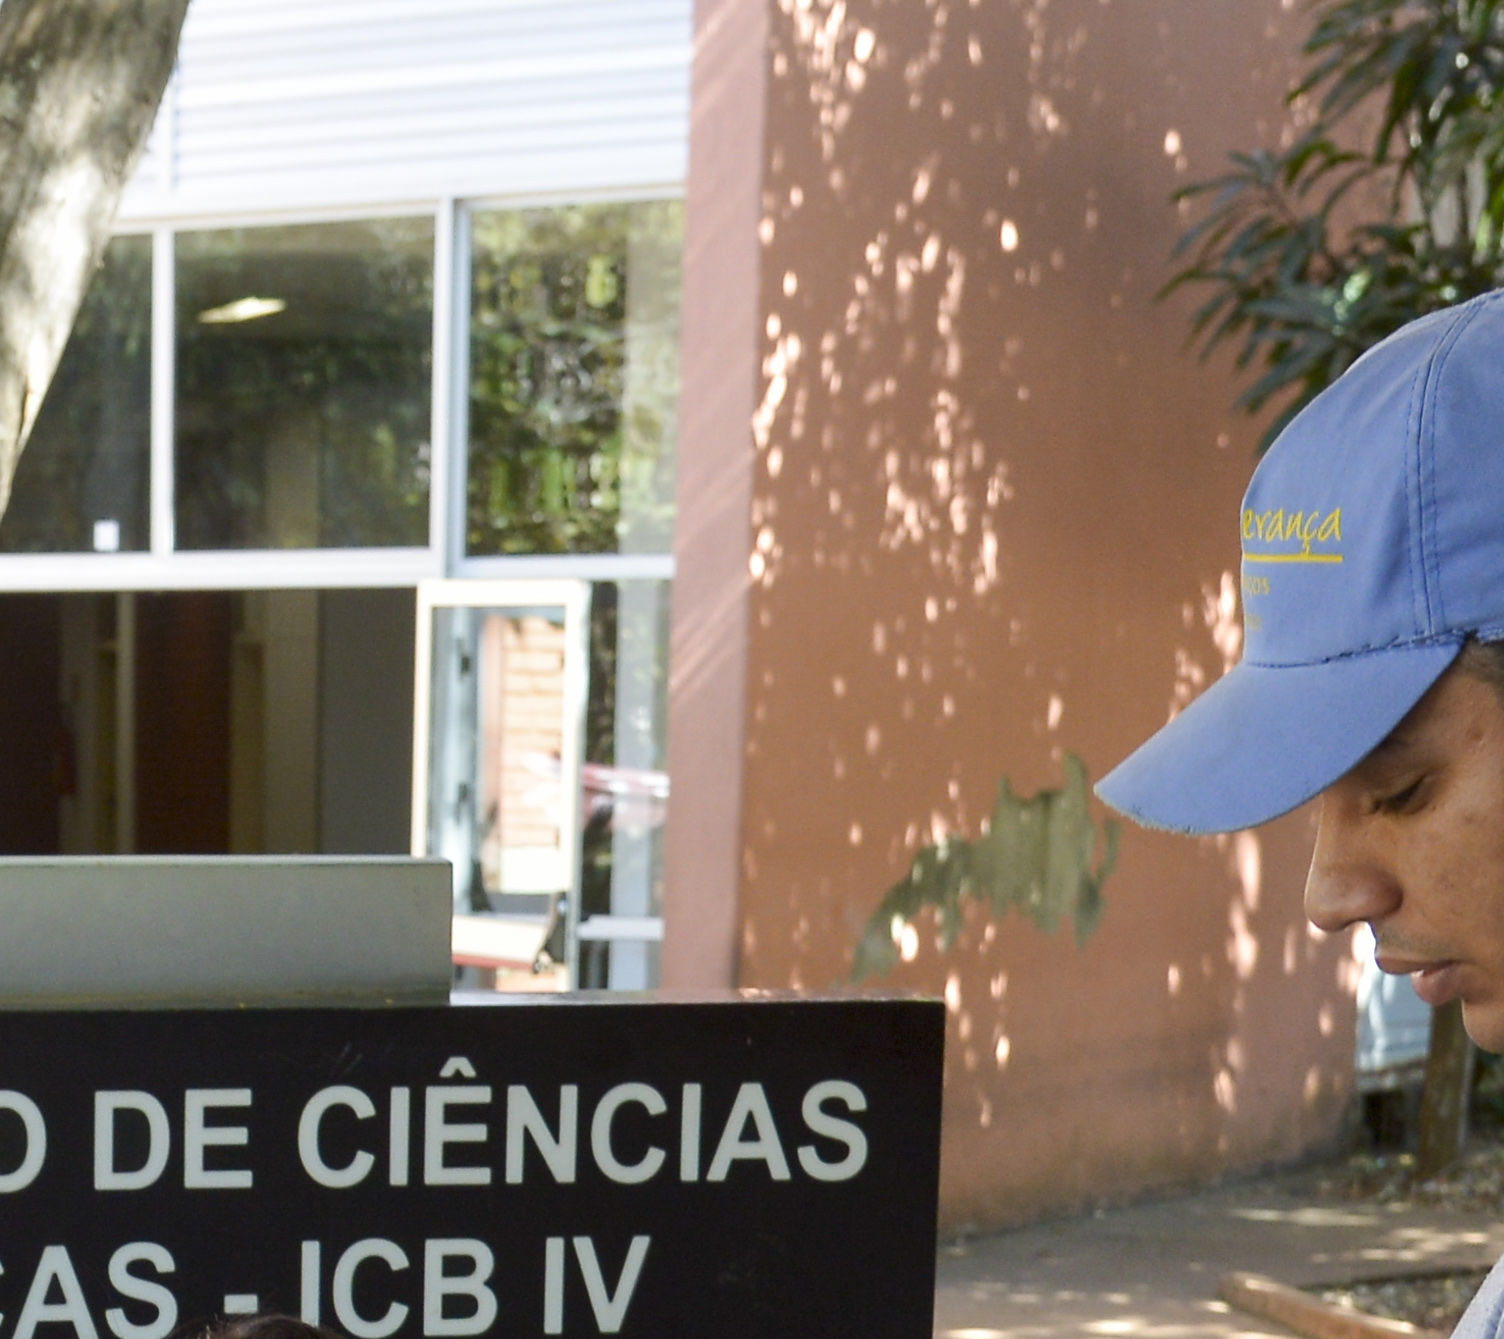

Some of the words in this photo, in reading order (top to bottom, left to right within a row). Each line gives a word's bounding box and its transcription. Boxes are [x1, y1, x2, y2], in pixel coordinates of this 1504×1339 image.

[1243, 507, 1342, 552] erança
[94, 1086, 252, 1190] DE
[297, 1056, 868, 1187] CIÊNCIAS
[224, 1294, 258, 1313] -
[301, 1237, 498, 1339] ICB
[544, 1233, 651, 1333] IV
